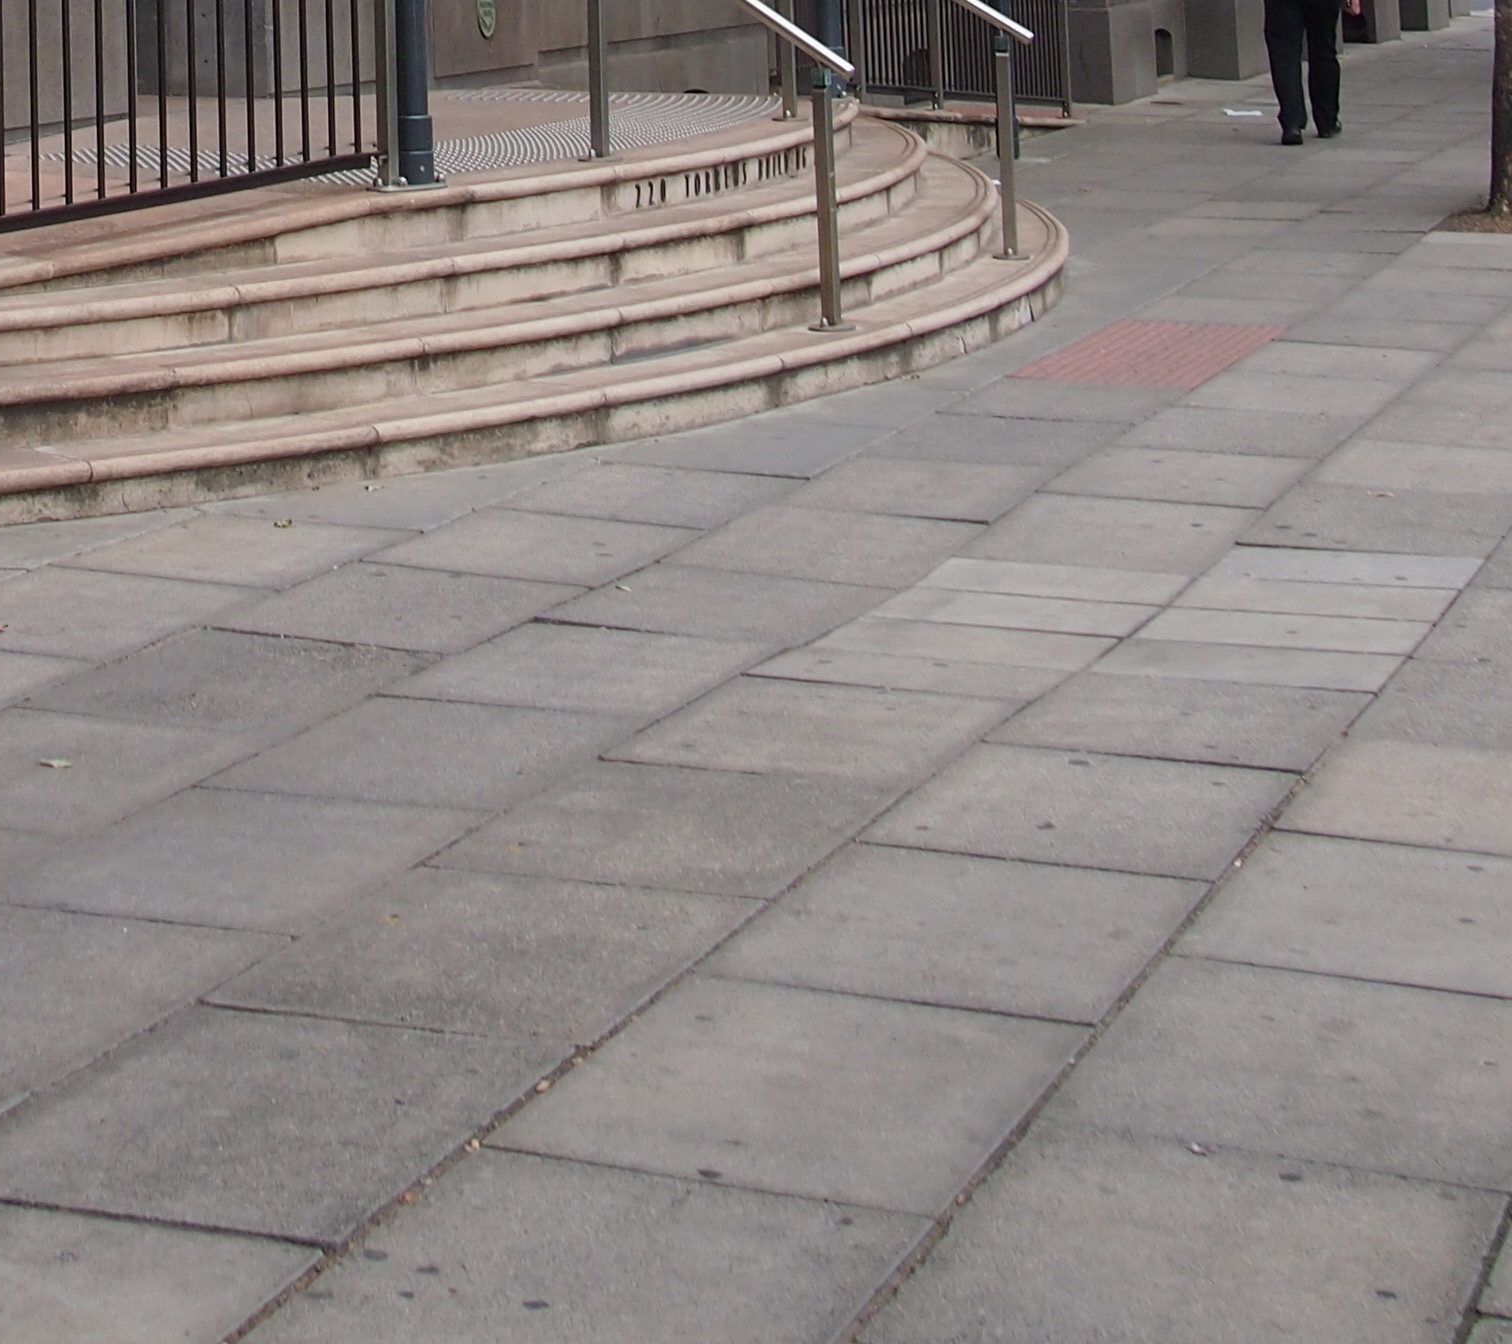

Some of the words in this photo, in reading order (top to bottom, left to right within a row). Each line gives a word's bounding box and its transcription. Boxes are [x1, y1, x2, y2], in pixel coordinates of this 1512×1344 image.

[635, 178, 667, 209] 220
[684, 162, 747, 198] TORRENS
[758, 147, 806, 182] BUILDNG
